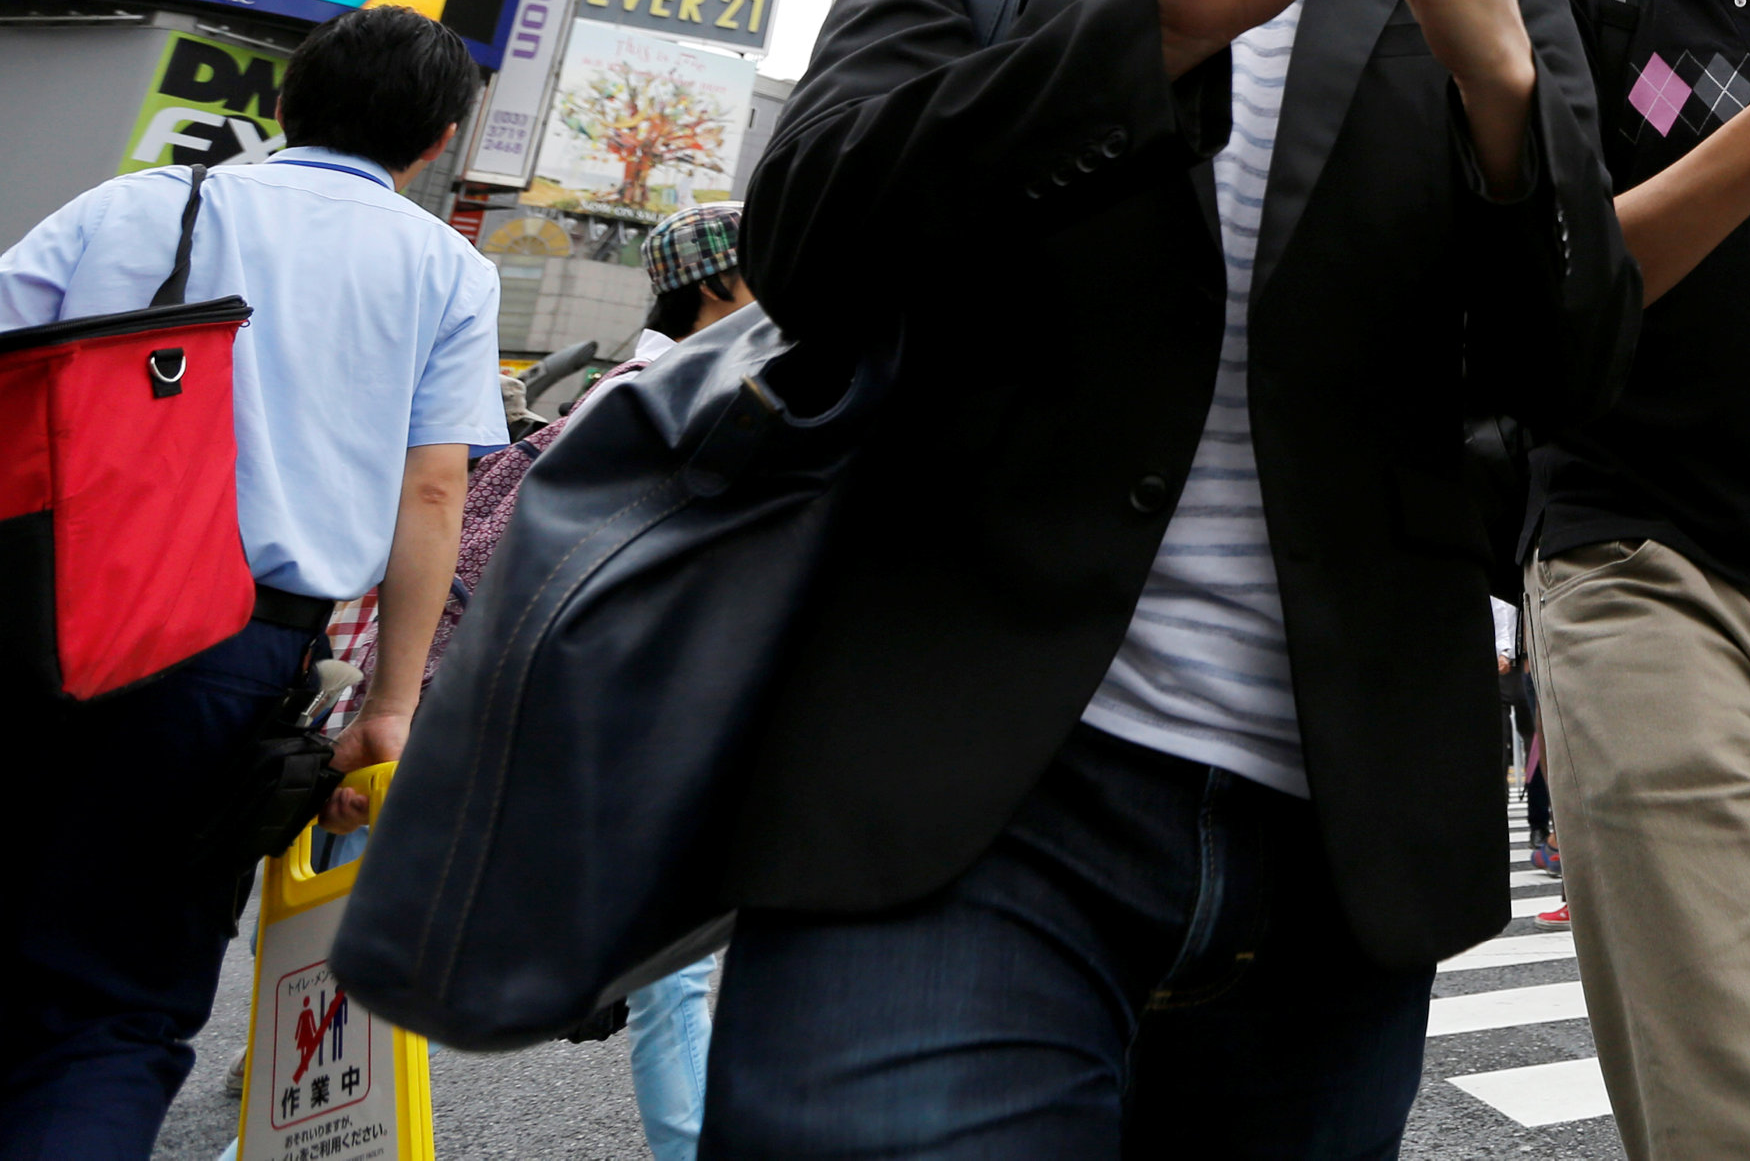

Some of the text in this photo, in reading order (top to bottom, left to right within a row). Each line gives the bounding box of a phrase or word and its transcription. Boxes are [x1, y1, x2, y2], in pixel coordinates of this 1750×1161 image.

[157, 36, 282, 121] DM
[131, 106, 288, 166] FX
[281, 1064, 361, 1120] 作業中
